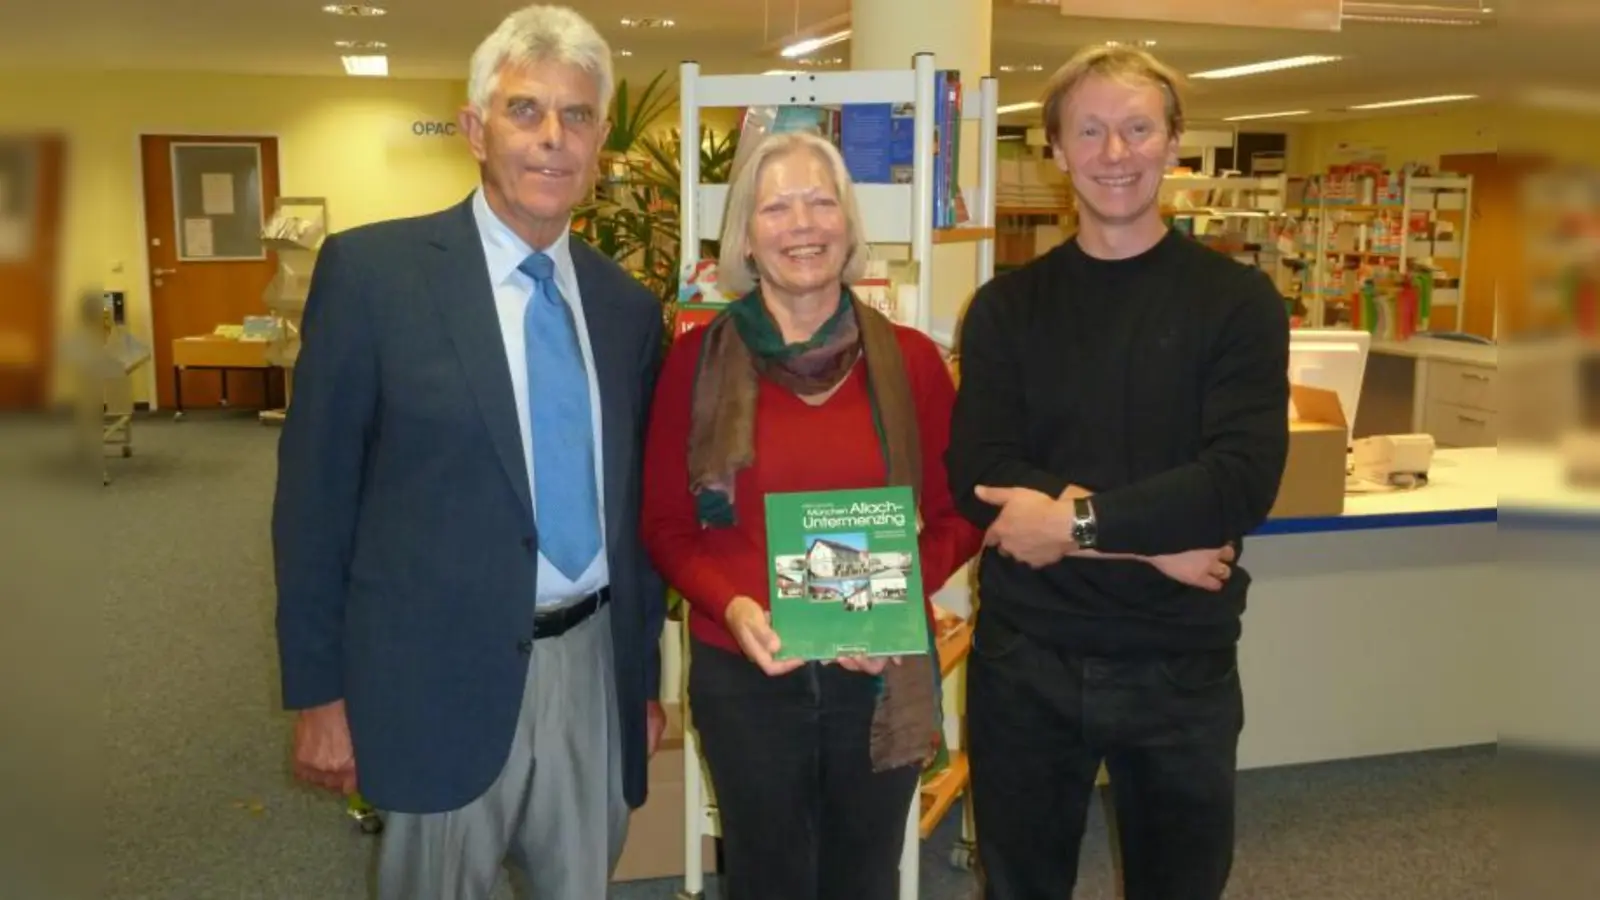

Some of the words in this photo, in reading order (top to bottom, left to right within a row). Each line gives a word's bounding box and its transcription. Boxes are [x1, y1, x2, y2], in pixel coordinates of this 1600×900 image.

[412, 121, 456, 136] OPAC
[849, 501, 904, 514] Allach-
[803, 513, 906, 529] Untermenzing
